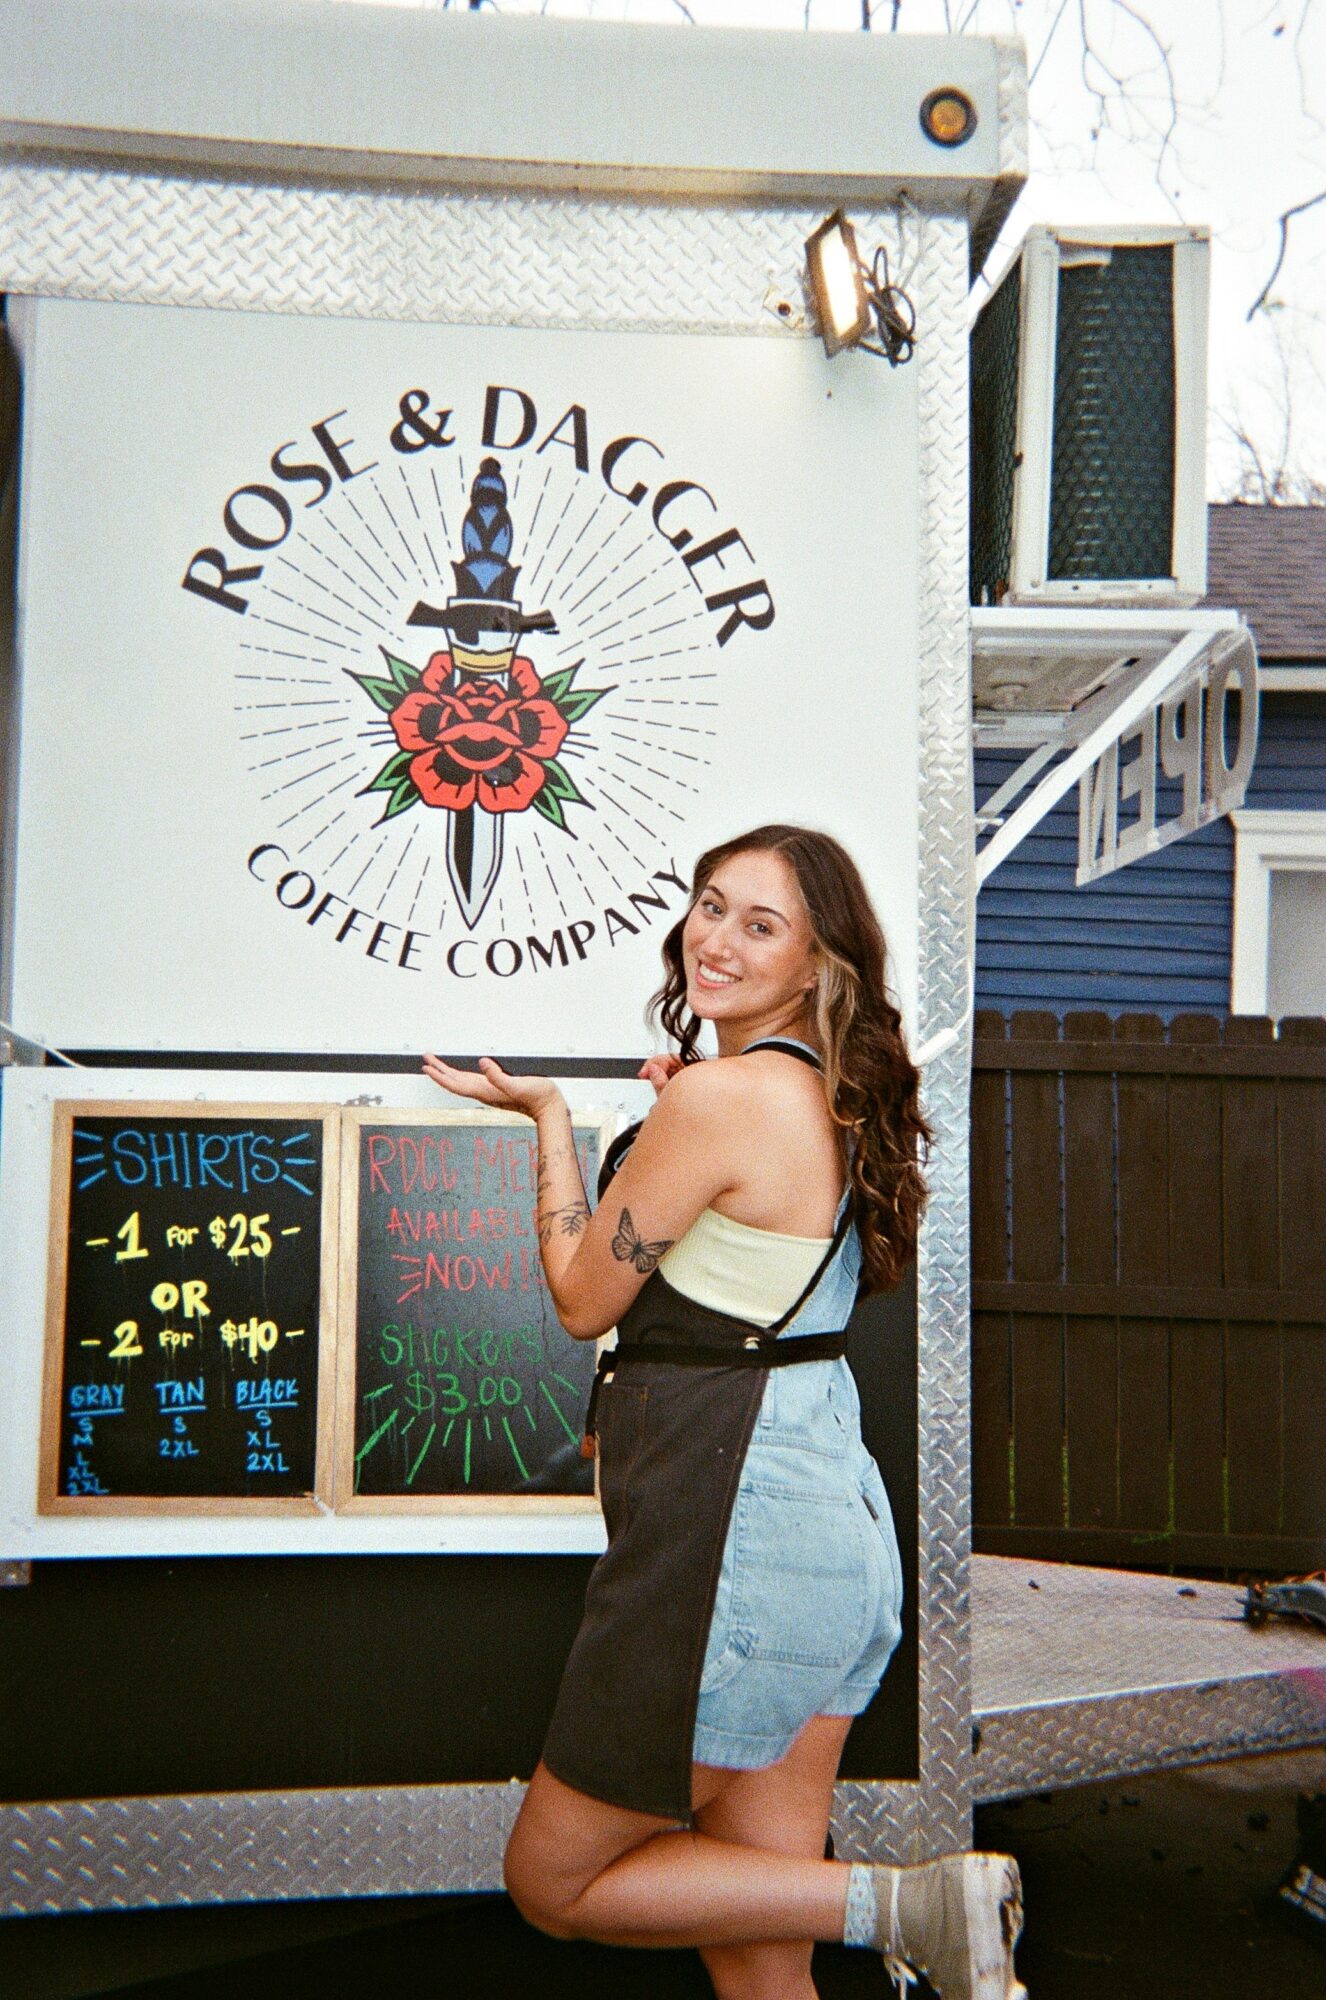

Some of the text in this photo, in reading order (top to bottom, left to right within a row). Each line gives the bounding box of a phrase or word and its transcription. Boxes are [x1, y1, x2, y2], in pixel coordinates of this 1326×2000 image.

[181, 385, 777, 648] ROSE & DAGGER
[246, 842, 690, 979] COFFEE COMPANY
[112, 1129, 281, 1193] SHIRTS
[368, 1134, 460, 1195] RDCC
[425, 1247, 530, 1292] NOW!
[150, 1280, 212, 1319] OR
[70, 1376, 299, 1408] GRAY TAN BLACK
[405, 1370, 522, 1416] $3.00
[78, 1417, 93, 1432] S
[174, 1416, 187, 1433] S
[256, 1410, 272, 1427] S
[159, 1438, 199, 1458] 2XL
[246, 1431, 281, 1449] XL
[246, 1452, 290, 1472] 2XL
